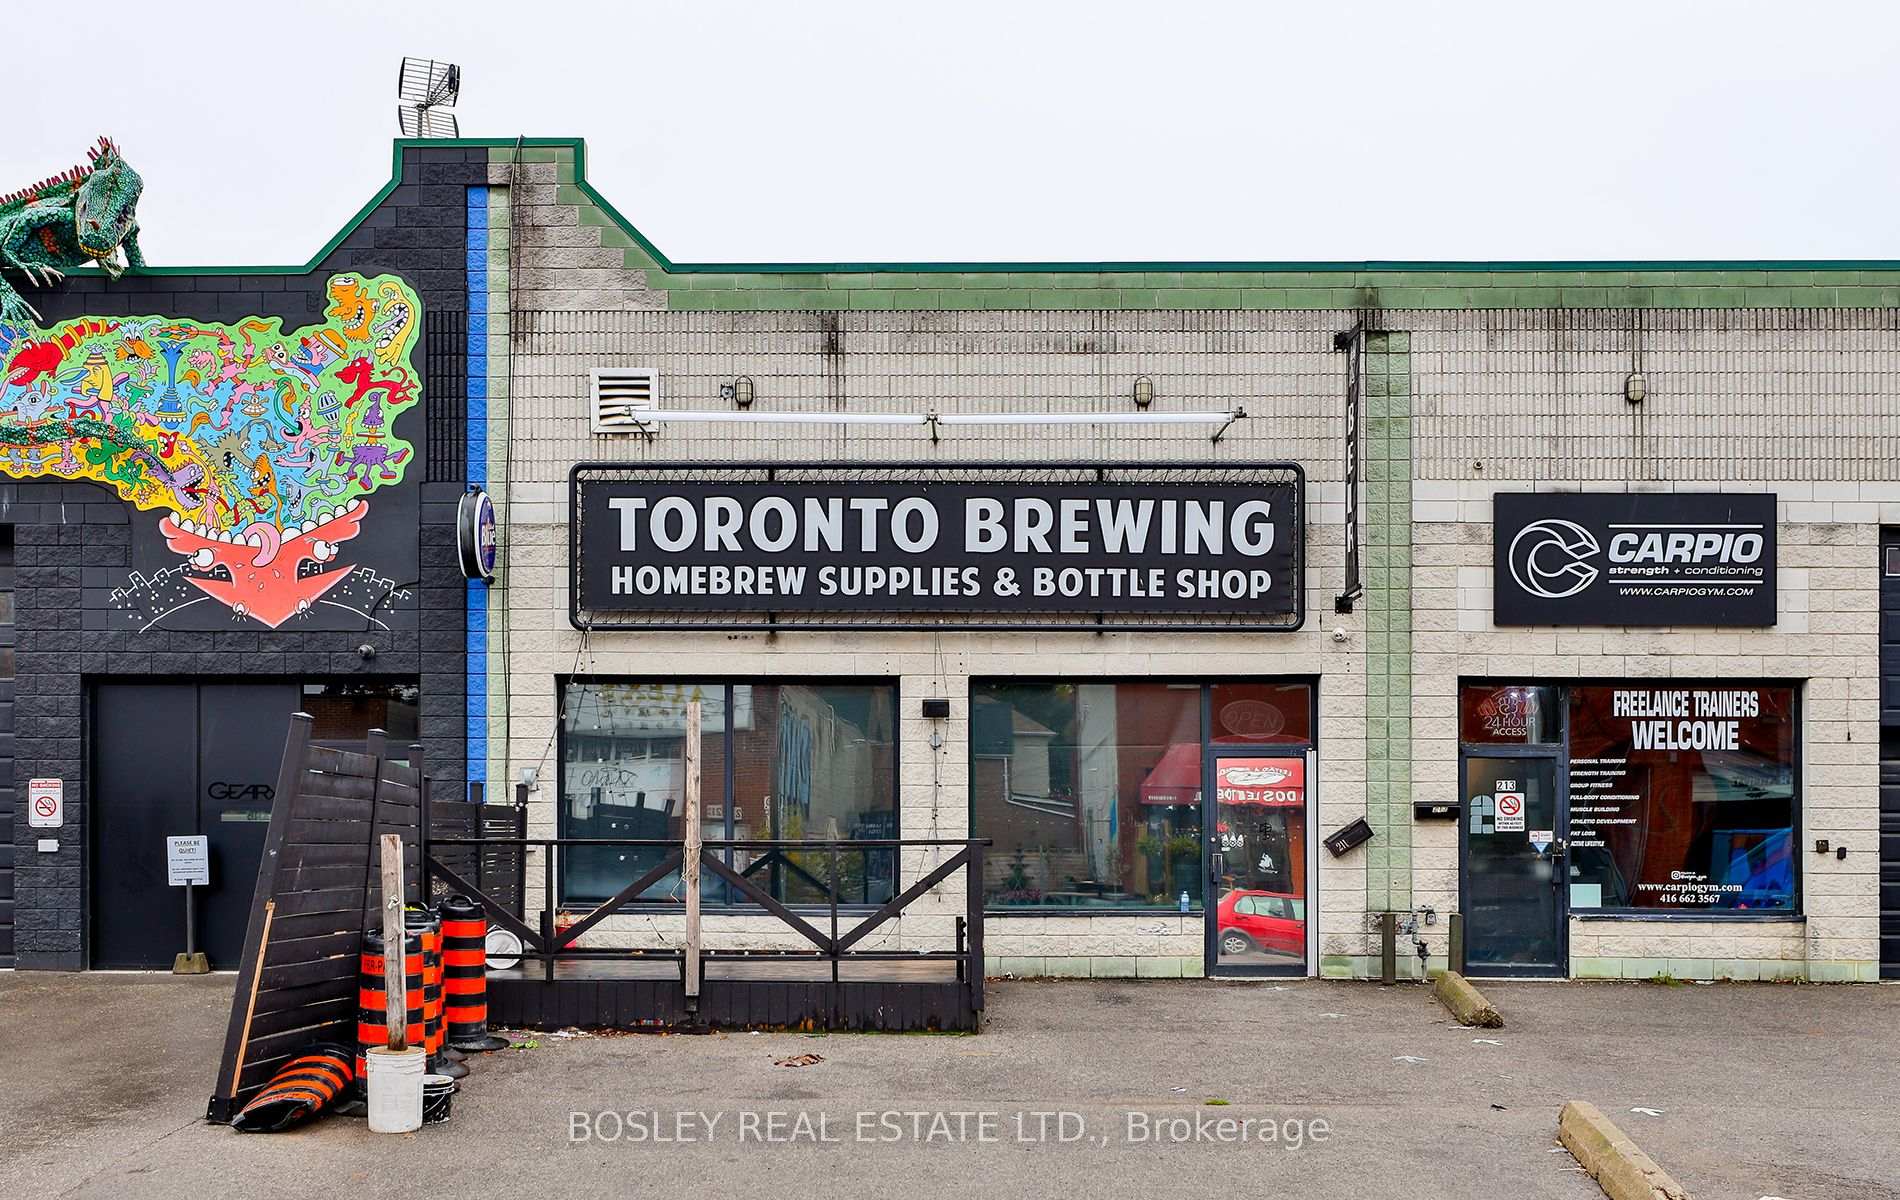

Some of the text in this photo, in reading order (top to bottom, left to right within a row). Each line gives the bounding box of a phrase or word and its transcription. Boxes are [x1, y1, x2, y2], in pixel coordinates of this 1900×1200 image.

[608, 496, 1275, 556] TORONTO BREWING
[1608, 532, 1764, 563] CARPIO
[1608, 566, 1670, 577] strength
[1684, 566, 1764, 577] conditioning
[611, 565, 1272, 599] HOMEBREW SUPPLIES & BOTTLE SHOP
[1619, 587, 1754, 596] WWW.CARPIOGYM.COM
[1613, 690, 1759, 718] FREELANCE TRAINERS
[1223, 710, 1280, 729] OPEN
[1484, 715, 1536, 729] 24 HOUR
[1492, 727, 1527, 736] ACCESS
[1632, 720, 1739, 750] WELCOME
[1497, 781, 1515, 791] 213
[1335, 839, 1350, 852] 211
[1637, 882, 1743, 894] www.carpiogym.com
[1659, 893, 1721, 903] 416 662 3567
